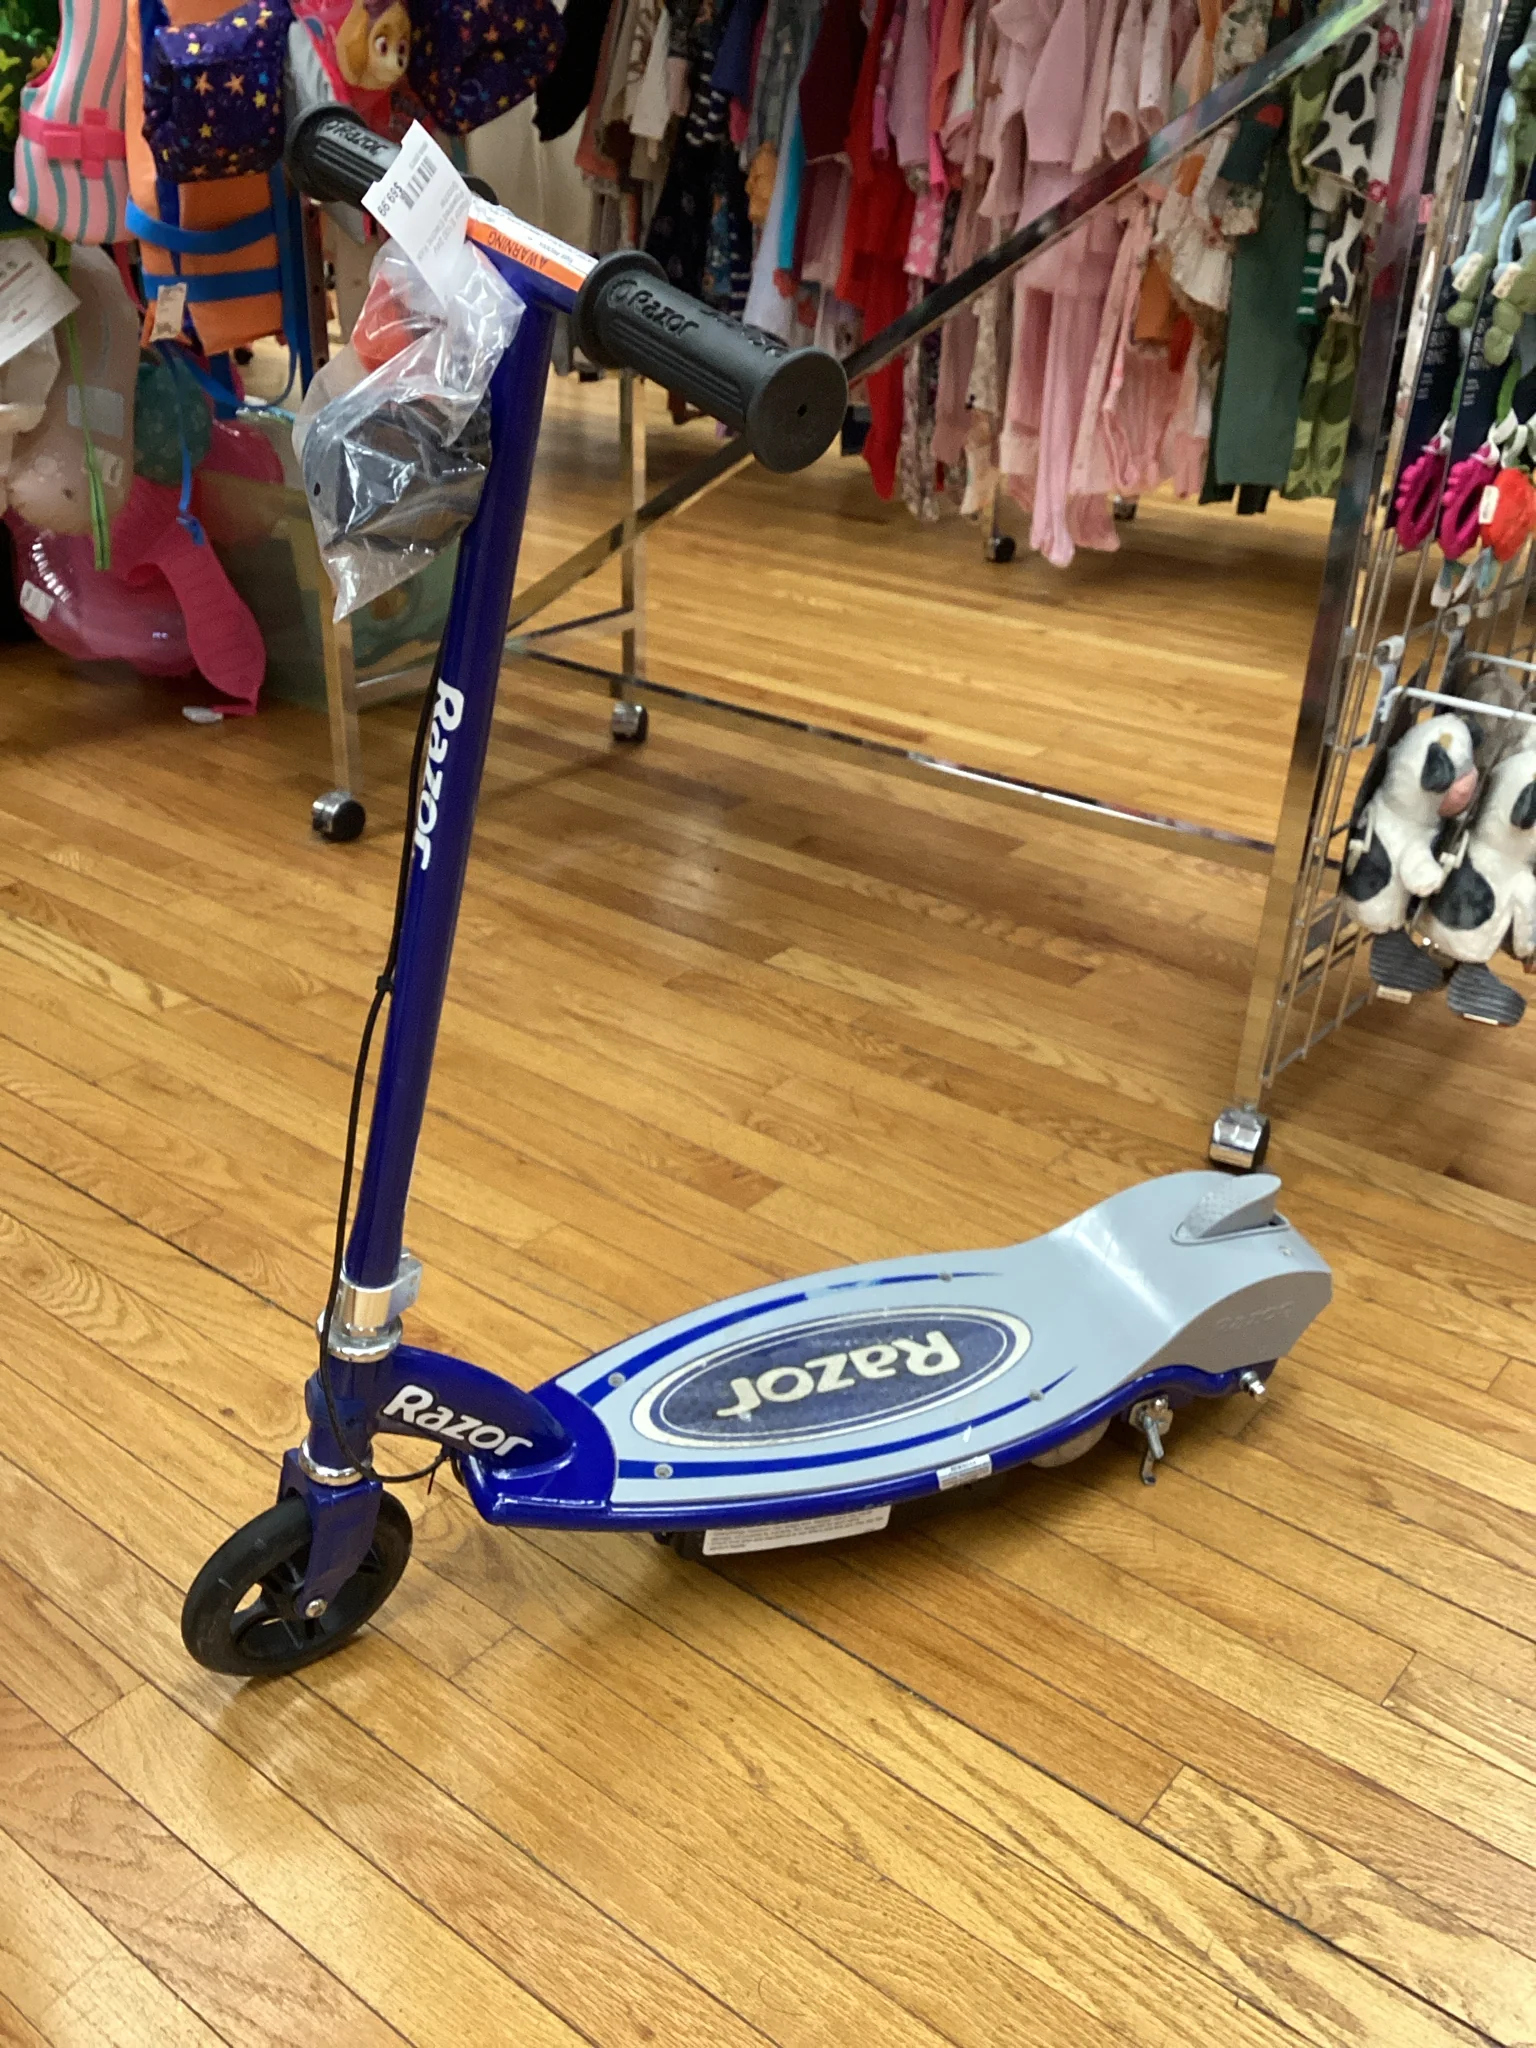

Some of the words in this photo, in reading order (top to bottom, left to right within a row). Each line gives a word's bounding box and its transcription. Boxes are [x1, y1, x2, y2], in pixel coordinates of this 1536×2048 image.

[376, 180, 404, 217] $69.99
[486, 230, 543, 267] WARNING
[629, 288, 699, 337] Razor
[413, 678, 464, 870] Razor
[716, 1330, 961, 1418] Razor
[382, 1384, 534, 1457] Razor
